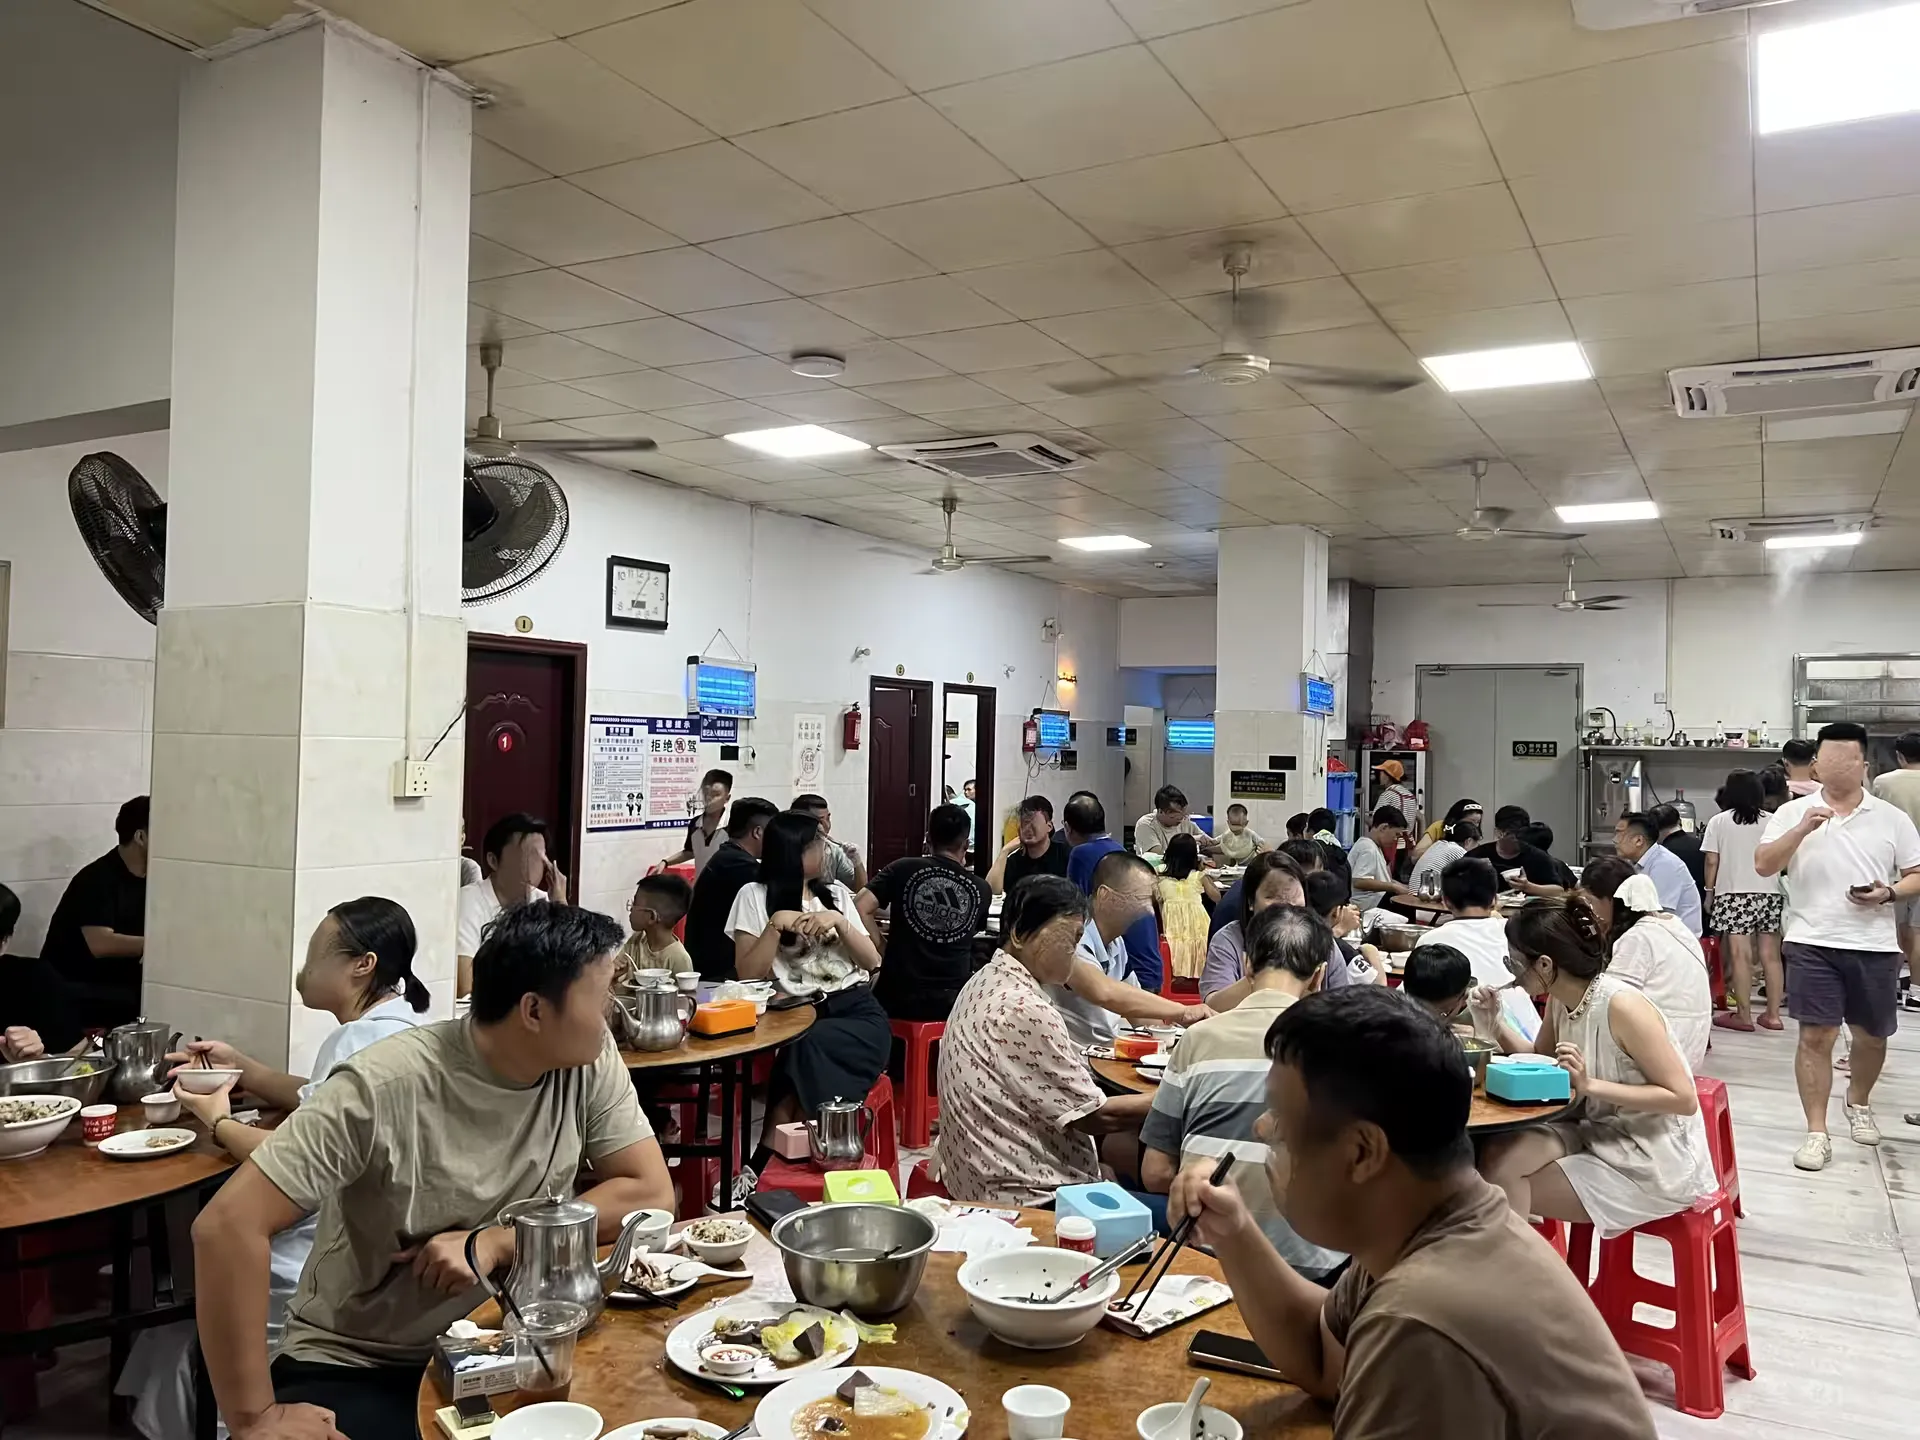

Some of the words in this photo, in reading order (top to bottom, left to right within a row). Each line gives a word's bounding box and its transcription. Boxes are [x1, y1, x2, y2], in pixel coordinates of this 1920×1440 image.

[618, 571, 626, 580] 10
[654, 577, 659, 586] 2
[660, 592, 665, 601] 3
[502, 736, 508, 748] 1
[651, 738, 697, 753] 拒绝酒驾
[914, 900, 966, 922] adidas
